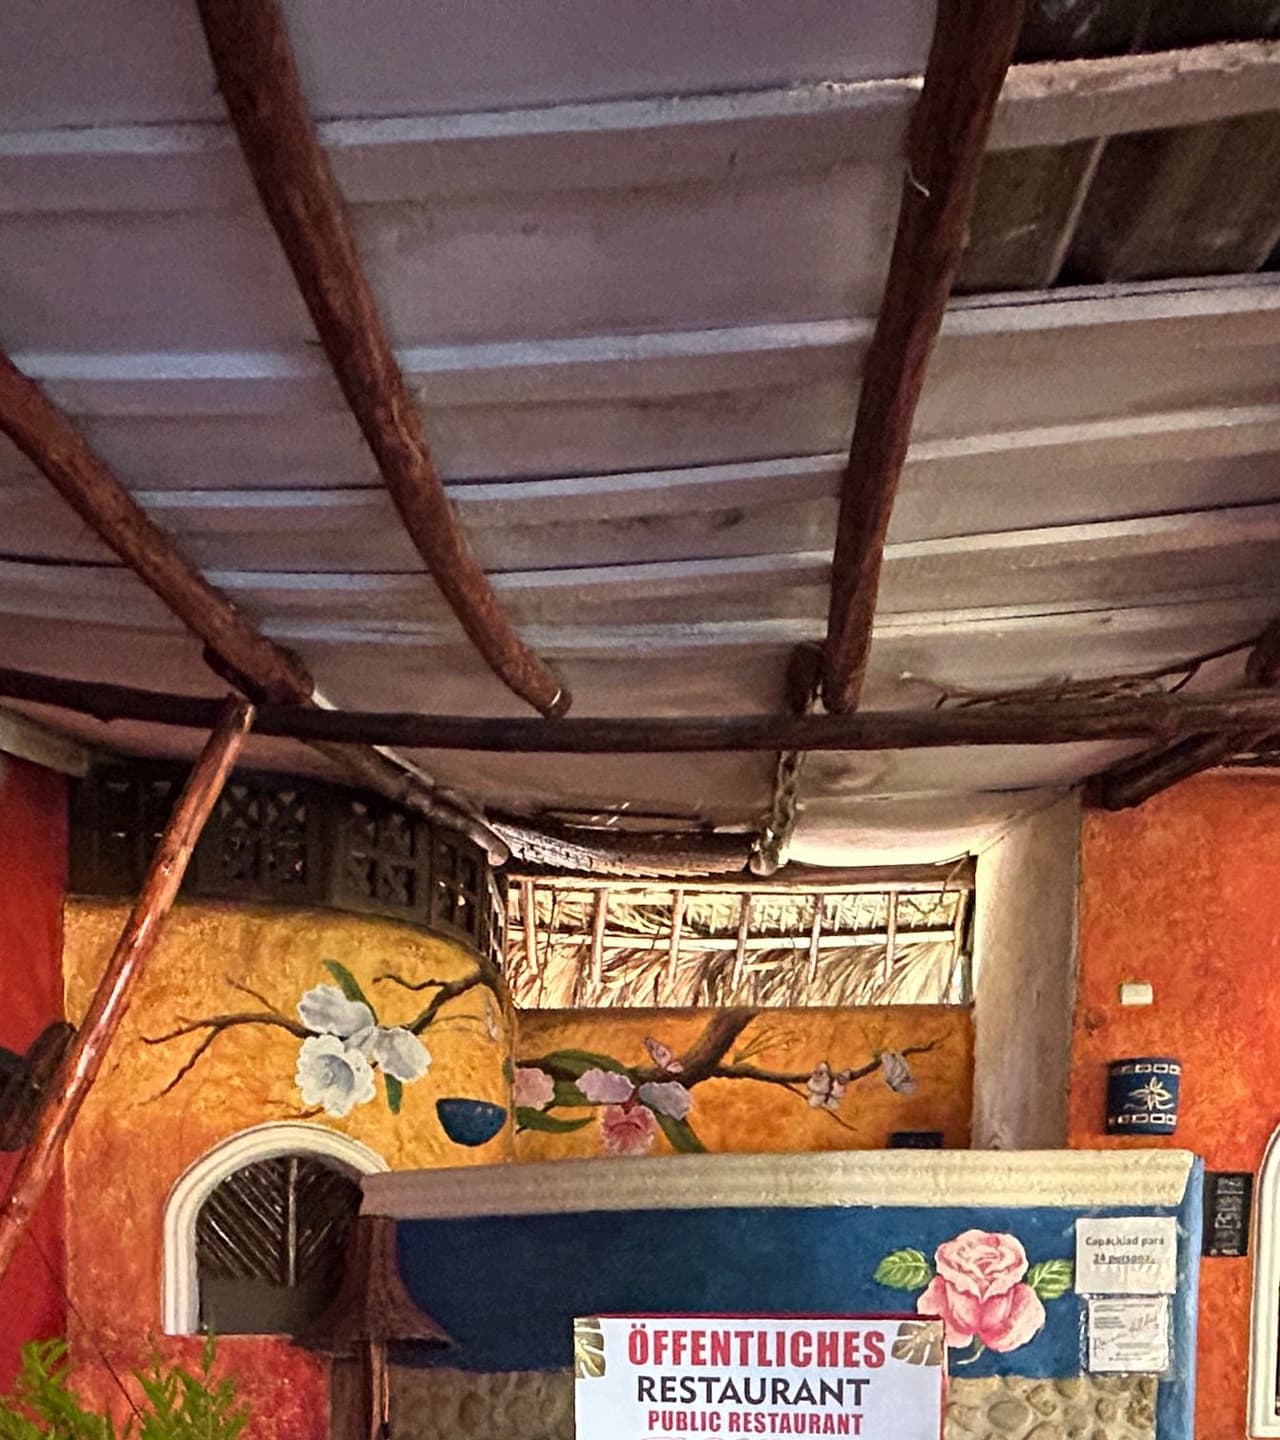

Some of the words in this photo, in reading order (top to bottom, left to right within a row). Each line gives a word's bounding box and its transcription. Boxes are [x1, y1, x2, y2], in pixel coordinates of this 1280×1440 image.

[628, 1323, 886, 1368] ÖFFENTLICHES
[638, 1376, 870, 1406] RESTAURANT
[648, 1410, 721, 1433] PUBLIC
[728, 1412, 864, 1435] RESTAURANT
